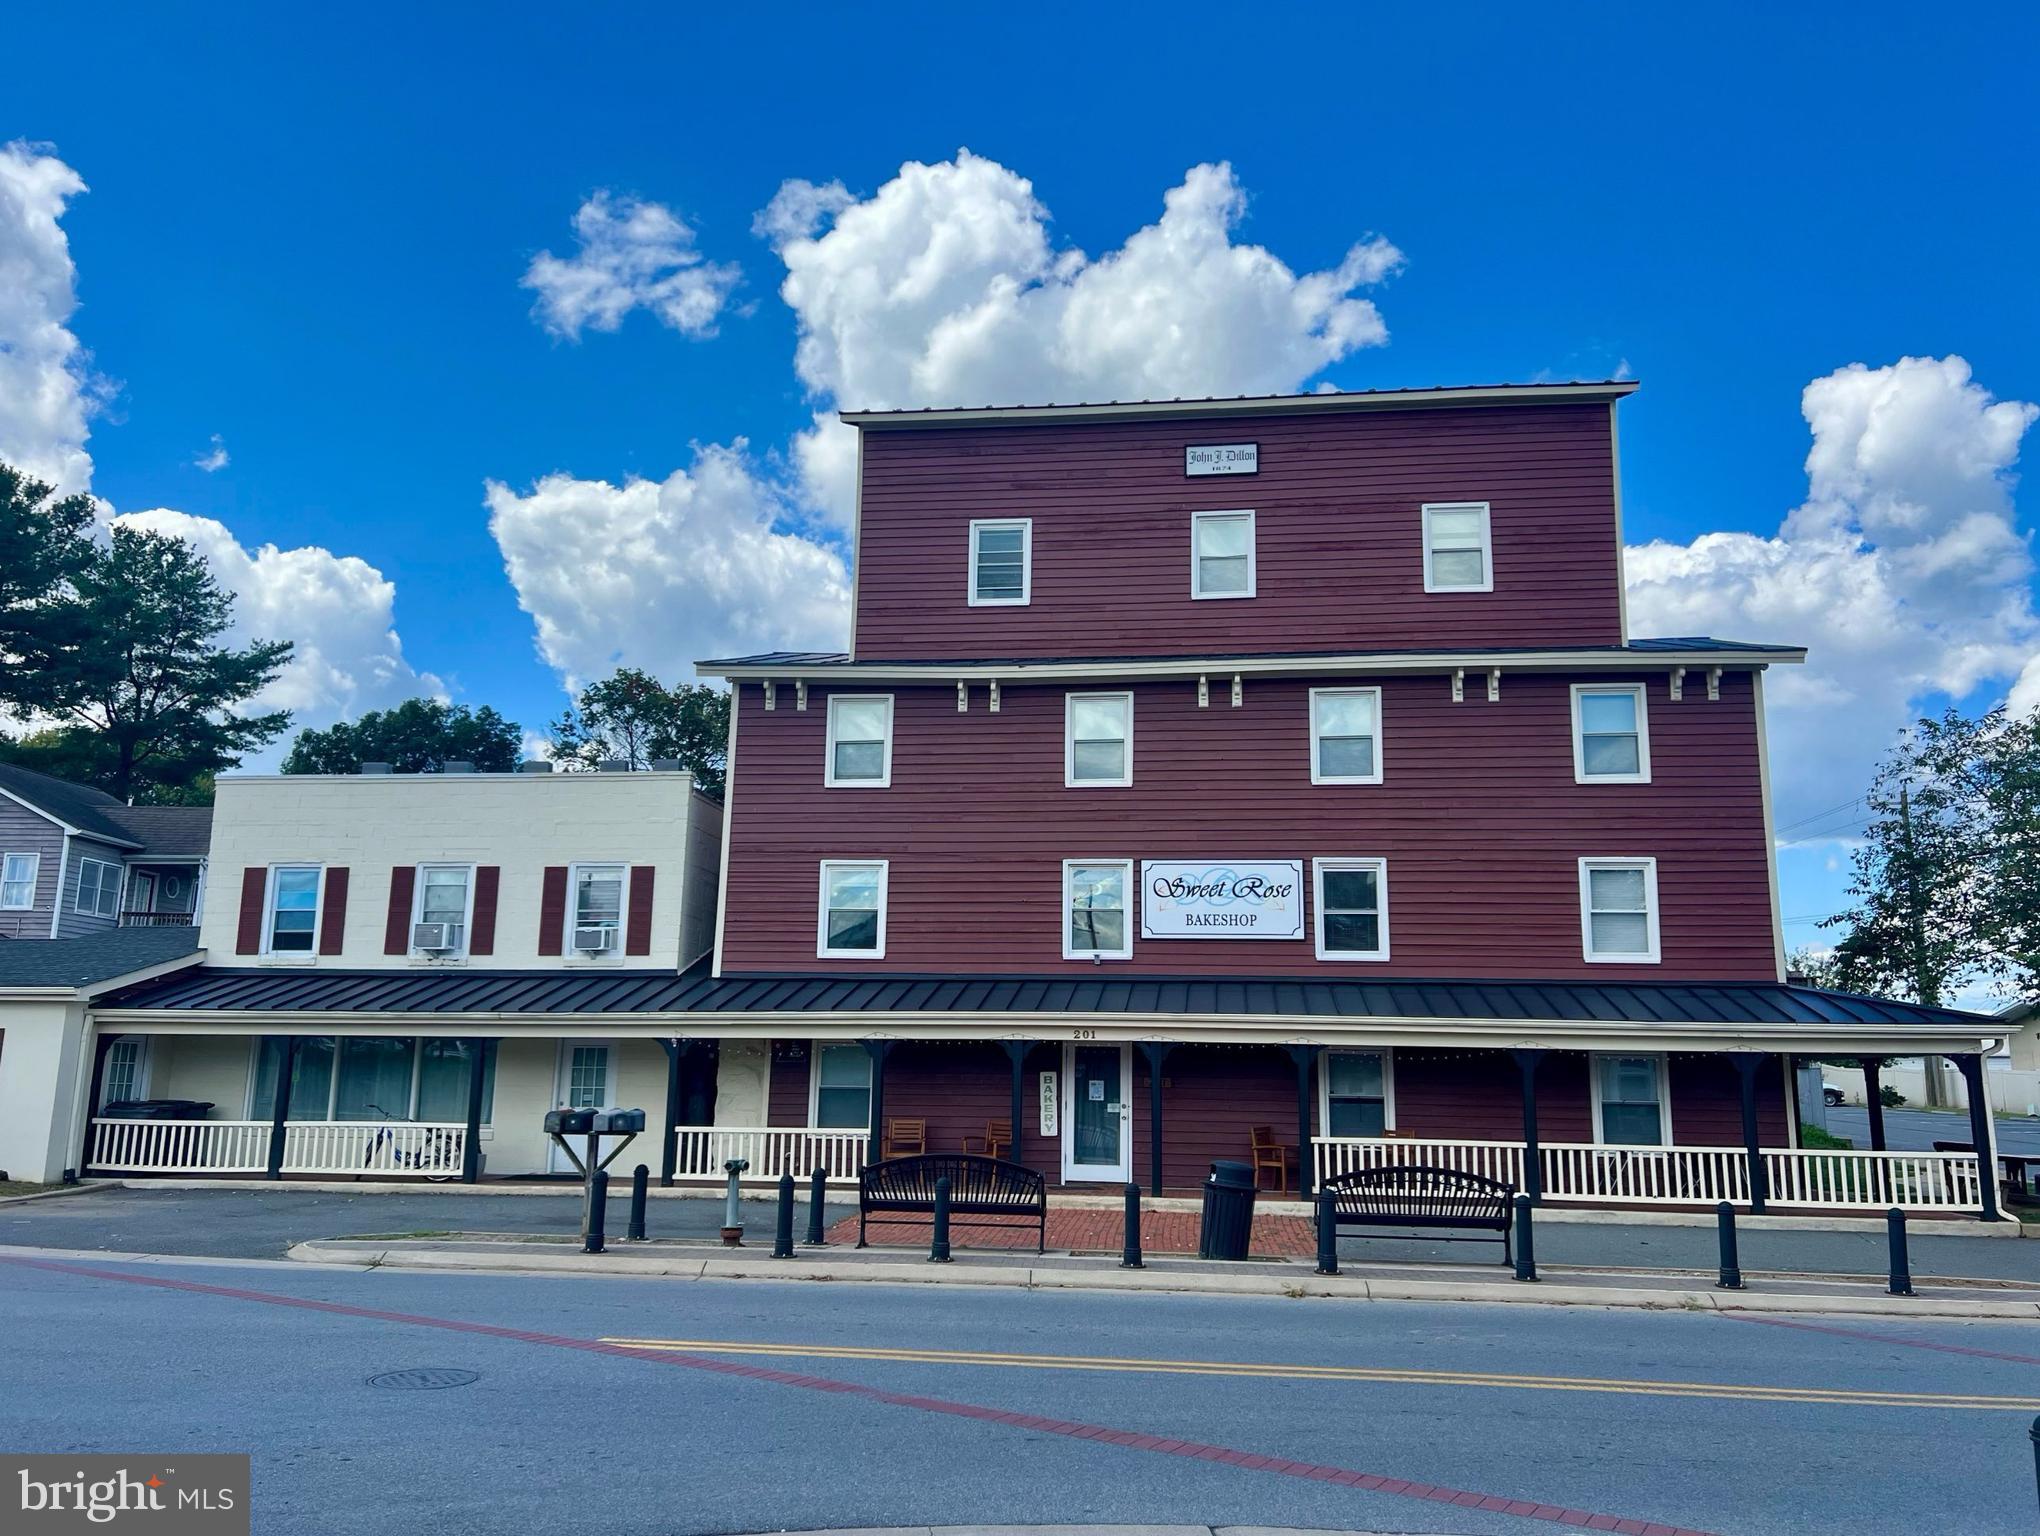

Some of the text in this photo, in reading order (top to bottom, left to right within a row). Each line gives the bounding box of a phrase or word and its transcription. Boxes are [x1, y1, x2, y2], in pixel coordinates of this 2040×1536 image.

[1189, 451, 1212, 464] John
[1226, 449, 1255, 461] Dillon
[1153, 877, 1292, 898] Sweet Rose
[1186, 914, 1257, 926] BAKESHOP
[1073, 1030, 1097, 1039] 201
[1043, 1076, 1053, 1132] BAKERY
